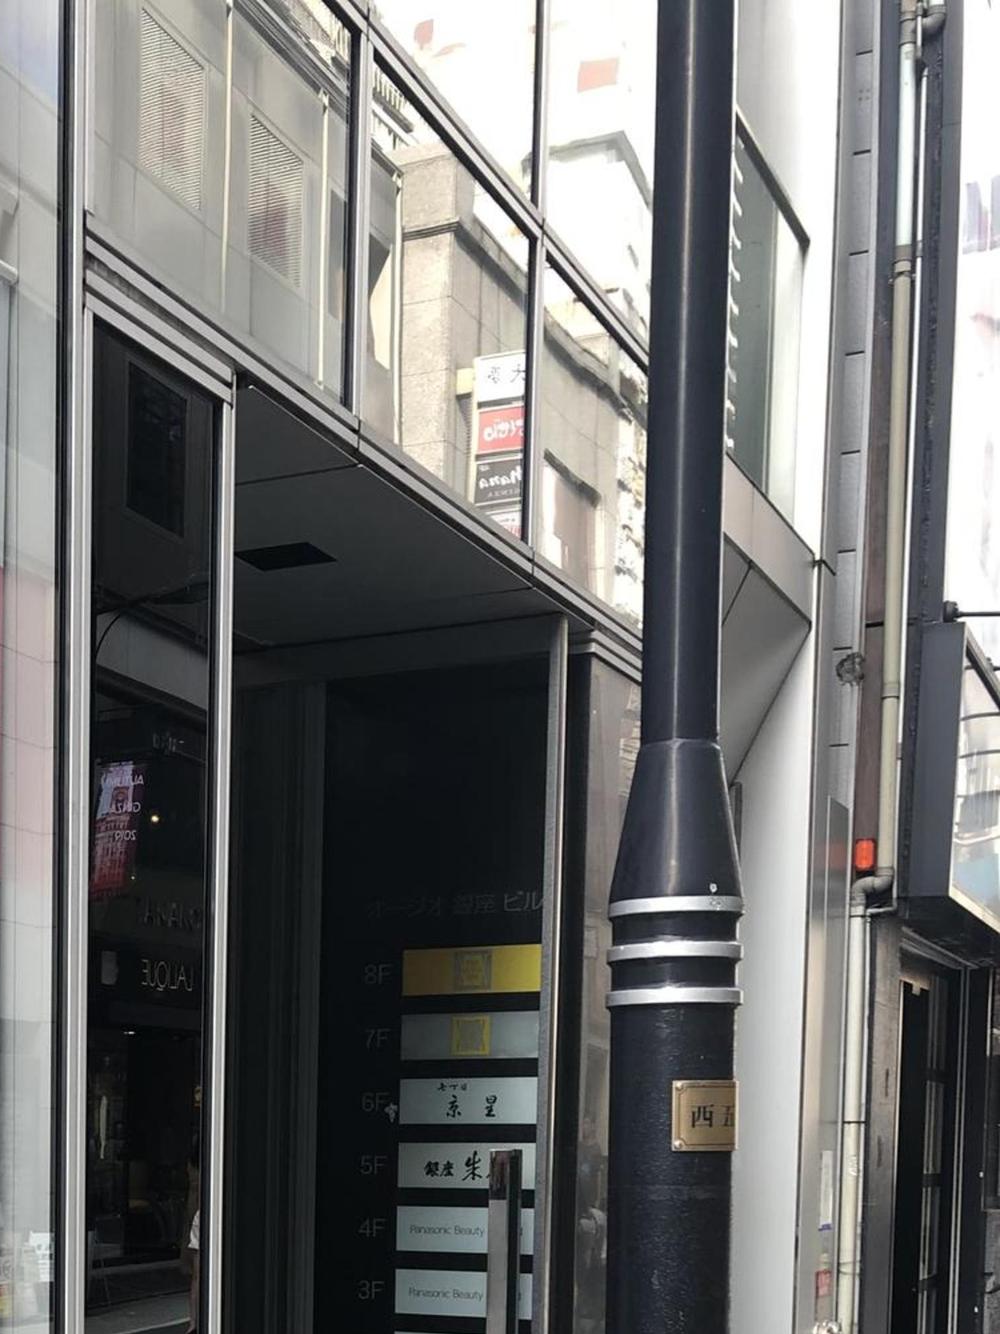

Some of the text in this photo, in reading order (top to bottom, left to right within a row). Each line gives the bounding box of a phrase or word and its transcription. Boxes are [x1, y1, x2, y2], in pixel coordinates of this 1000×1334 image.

[364, 963, 393, 985] 8F
[365, 1028, 390, 1049] 7F
[361, 1092, 390, 1112] 6F
[359, 1155, 388, 1175] 5F
[358, 1218, 387, 1237] 4F
[409, 1225, 485, 1237] Panasonic Beauty
[358, 1280, 385, 1299] 3F
[408, 1287, 484, 1301] Panasonic Beauty
